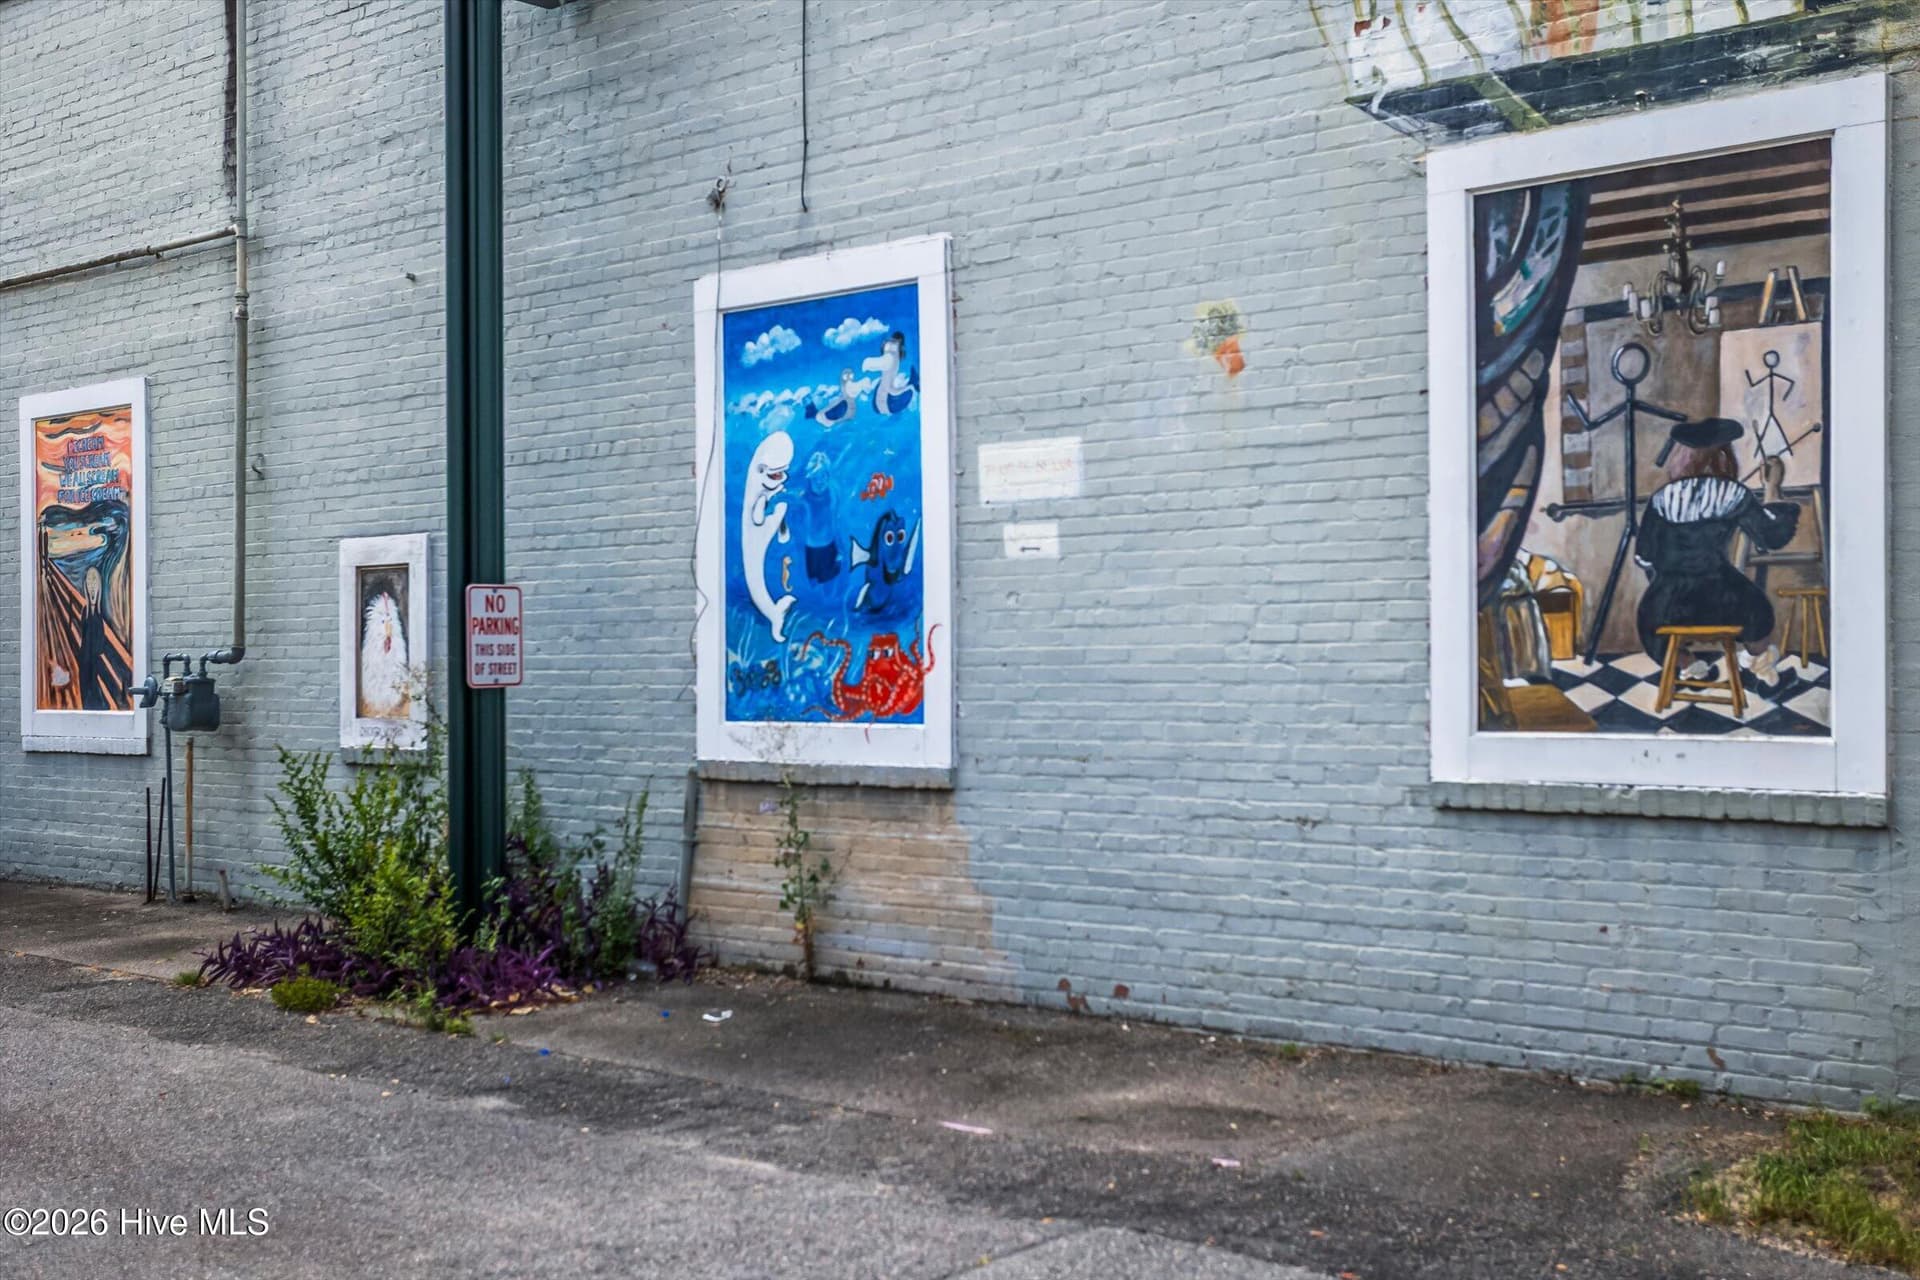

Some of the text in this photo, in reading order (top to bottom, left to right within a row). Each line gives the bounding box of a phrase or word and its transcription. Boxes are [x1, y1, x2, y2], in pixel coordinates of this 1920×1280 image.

[485, 595, 505, 612] NO
[472, 617, 519, 635] PARKING
[475, 644, 515, 656] THIS SIDE
[474, 662, 517, 675] OF STREET
